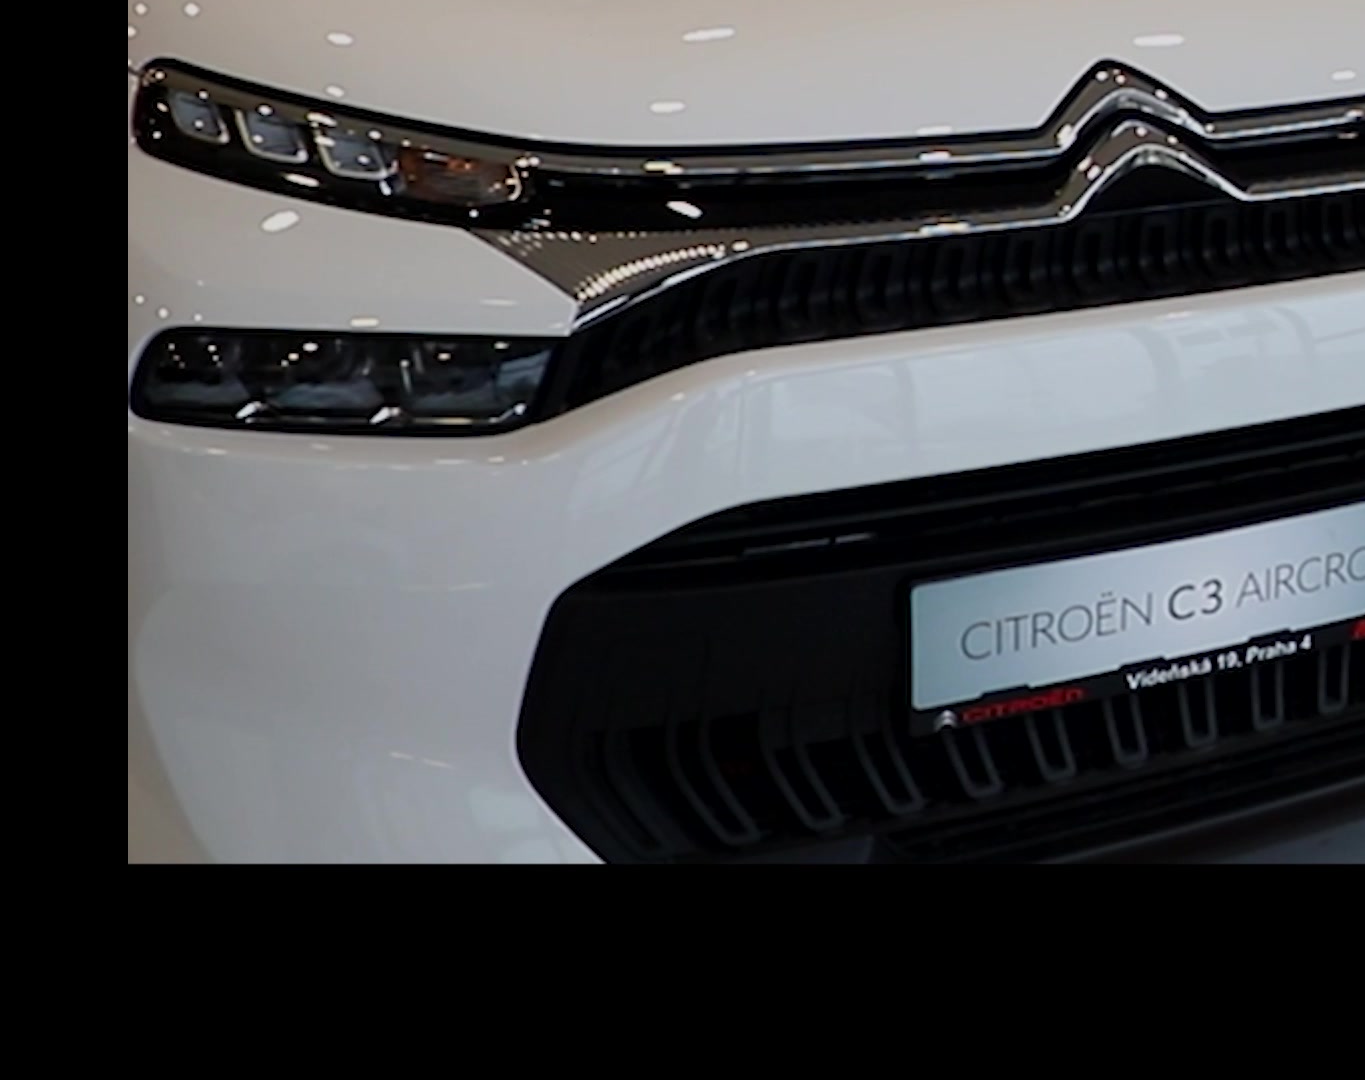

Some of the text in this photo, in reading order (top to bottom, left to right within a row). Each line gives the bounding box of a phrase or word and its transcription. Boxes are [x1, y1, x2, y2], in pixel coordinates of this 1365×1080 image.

[960, 591, 1154, 661] CITROËN
[1167, 578, 1223, 621] C3
[1246, 640, 1297, 664] Praha
[1300, 634, 1312, 650] 4
